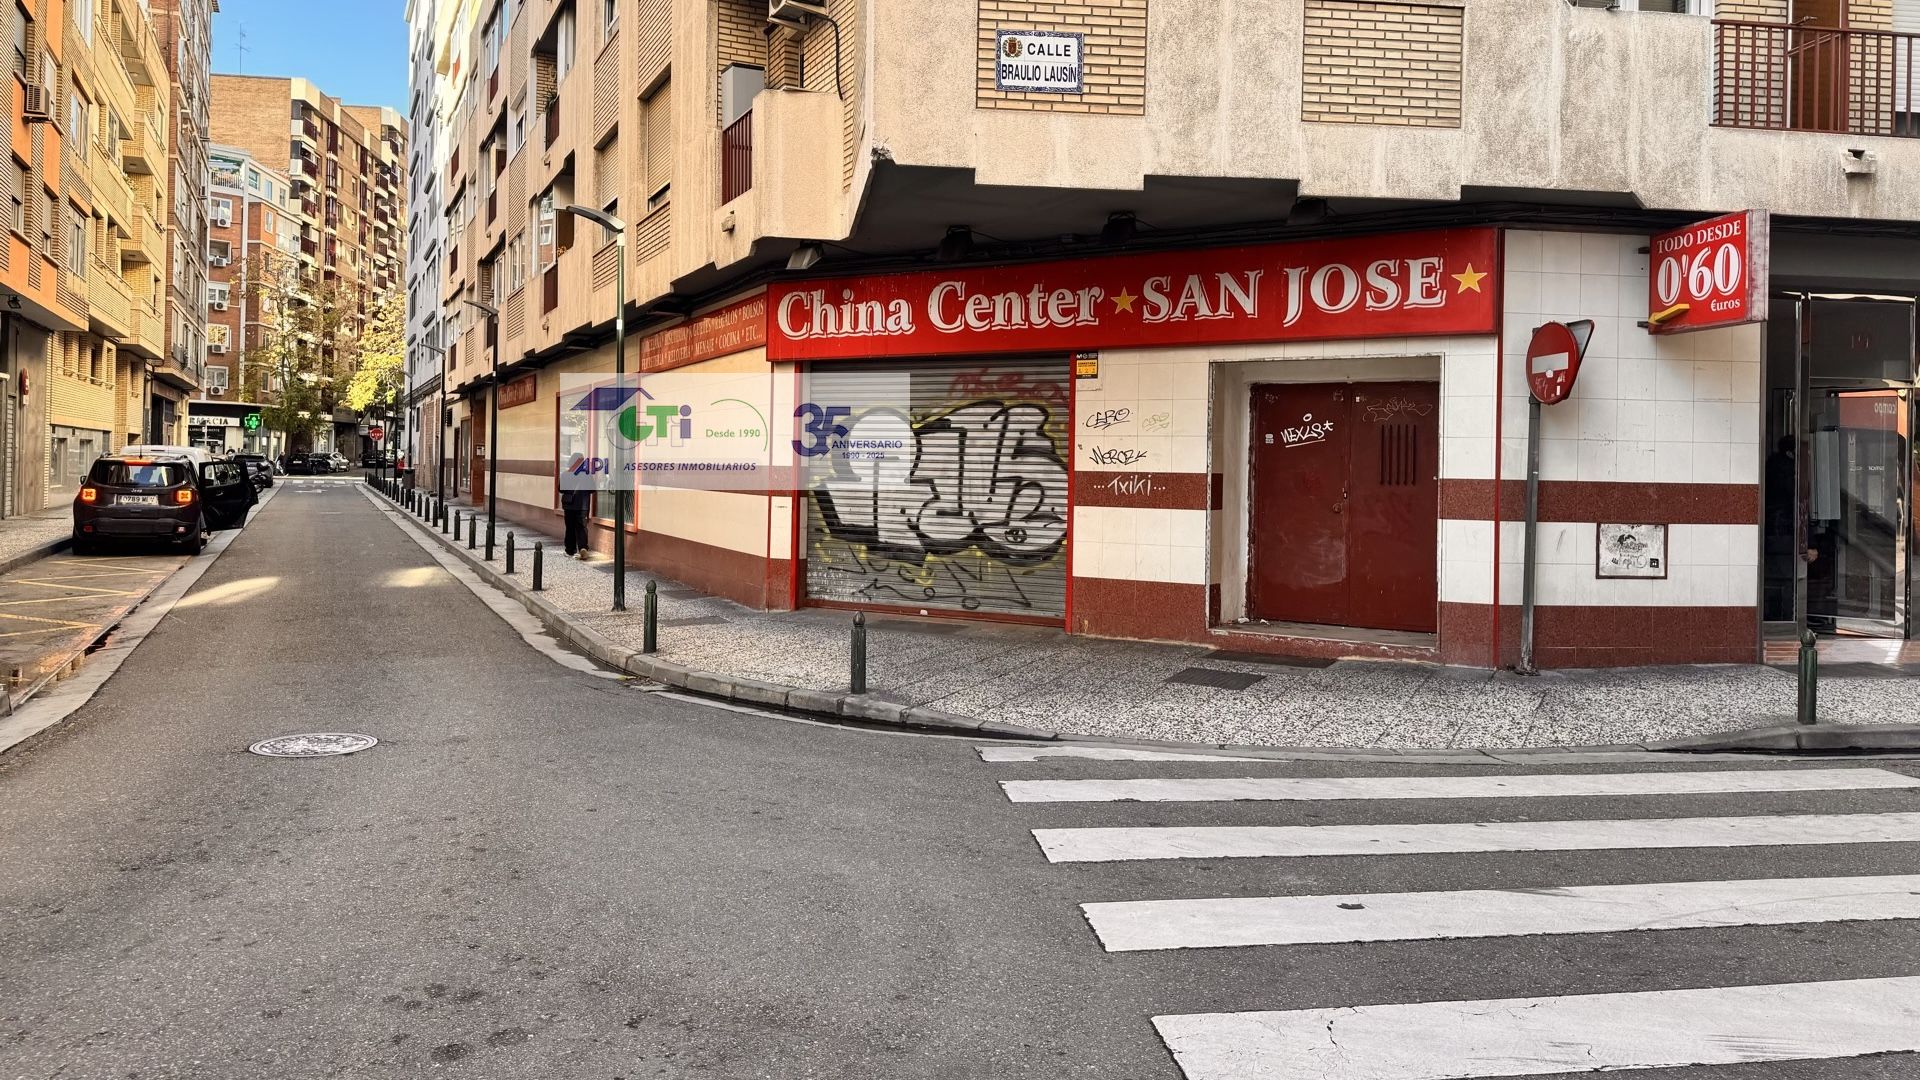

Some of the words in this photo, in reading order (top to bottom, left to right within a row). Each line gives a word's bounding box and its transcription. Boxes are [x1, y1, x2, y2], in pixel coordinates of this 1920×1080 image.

[1027, 43, 1071, 57] CALLE
[1001, 63, 1041, 81] BRAULIO
[1044, 64, 1077, 83] LAUSÍN
[1657, 232, 1693, 254] TODO
[1697, 219, 1742, 244] DESDE
[777, 288, 915, 340] China
[927, 280, 1105, 334] Center
[1142, 268, 1264, 324] SAN
[1282, 255, 1447, 328] JOSE
[742, 299, 764, 322] BOLSOS
[695, 336, 715, 355] MENAJE
[718, 329, 741, 350] COCINA
